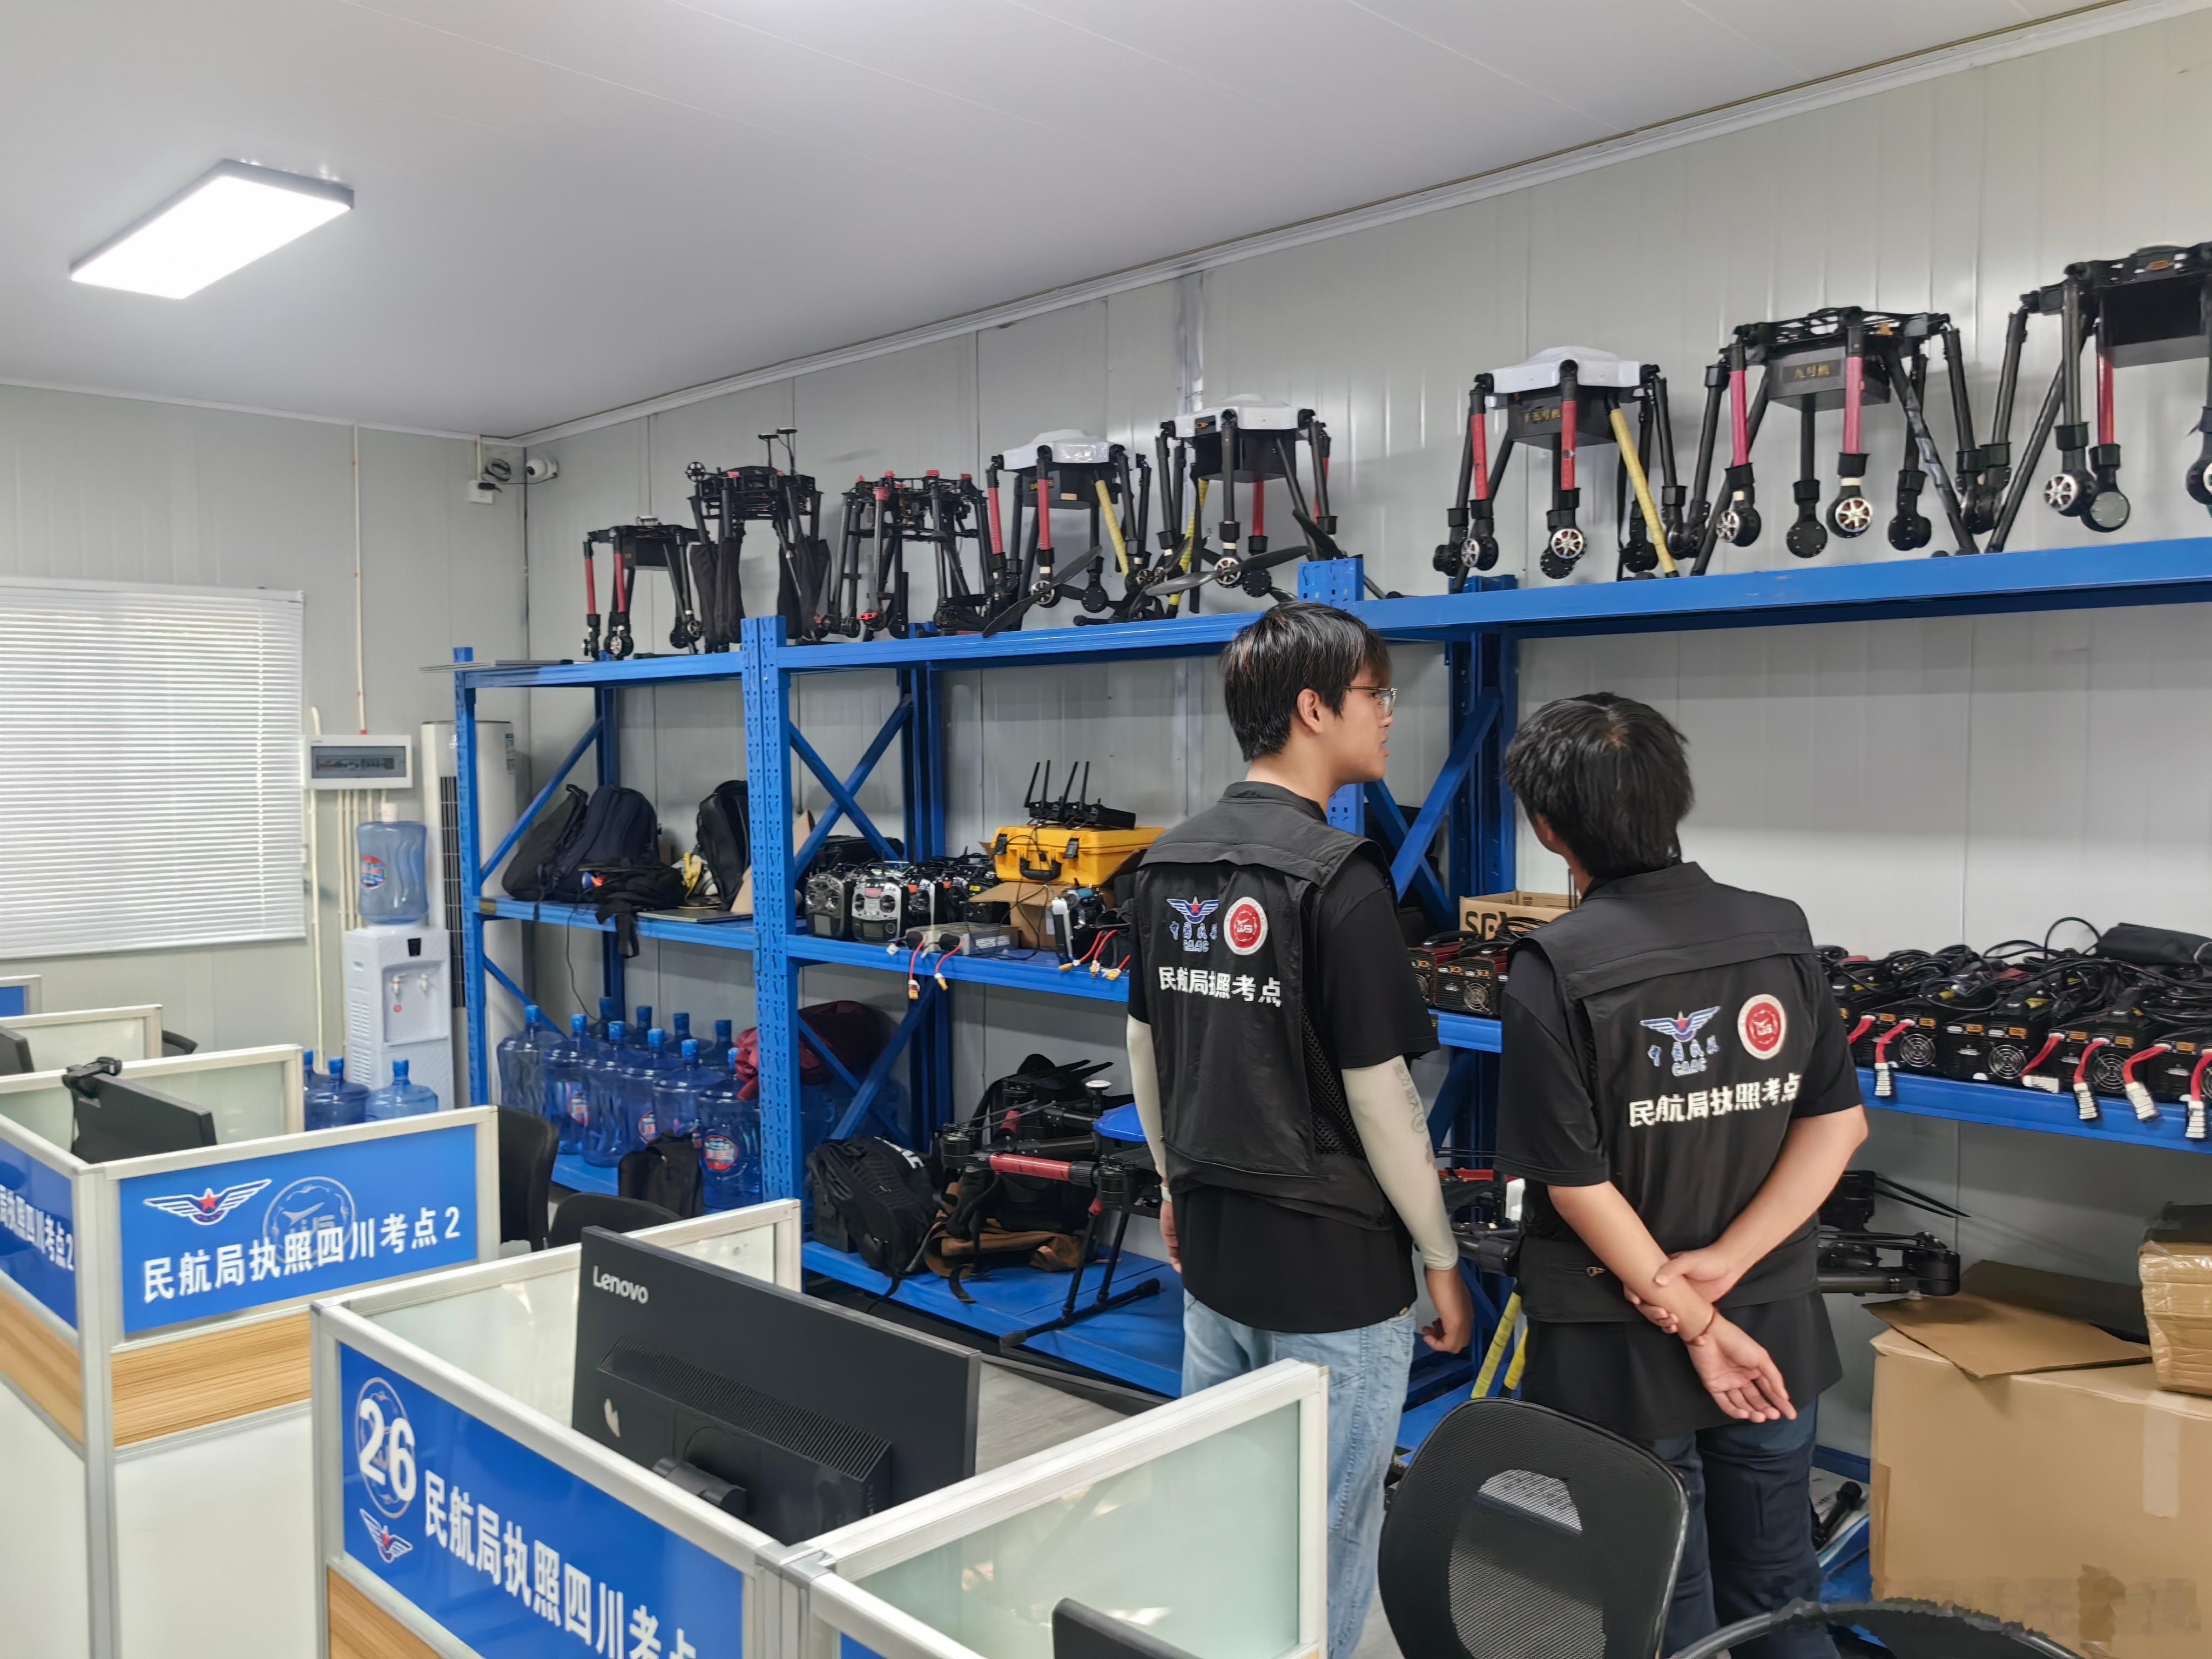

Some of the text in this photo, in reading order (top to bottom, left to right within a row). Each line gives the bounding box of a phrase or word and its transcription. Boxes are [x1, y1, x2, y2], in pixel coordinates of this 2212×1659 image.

[1628, 1072, 1802, 1128] 民航局执照考点
[144, 1205, 461, 1304] 民航局执照四川考点2
[592, 1265, 649, 1305] Lenovo
[360, 1398, 417, 1502] 26
